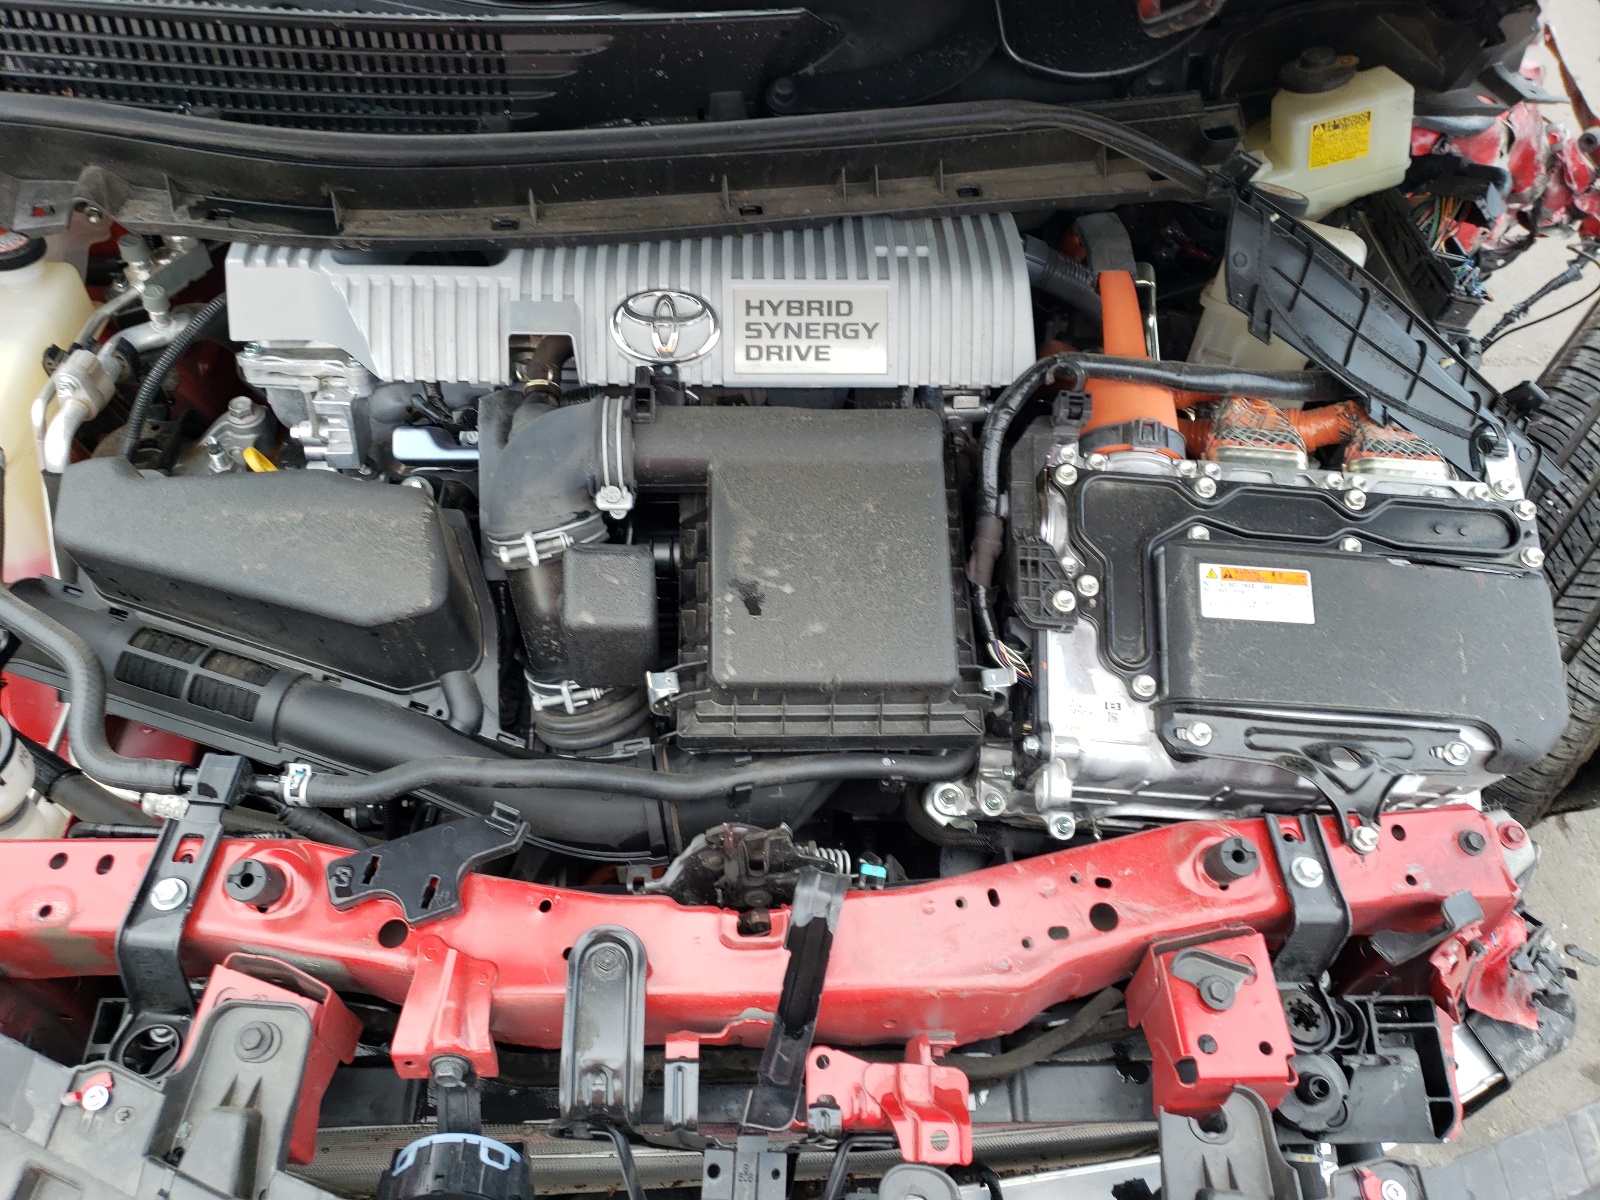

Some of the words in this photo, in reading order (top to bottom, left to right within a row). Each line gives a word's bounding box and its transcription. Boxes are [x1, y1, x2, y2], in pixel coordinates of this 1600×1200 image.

[745, 299, 853, 316] HYBRID
[745, 322, 880, 339] SYNERGY
[745, 345, 831, 361] DRIVE
